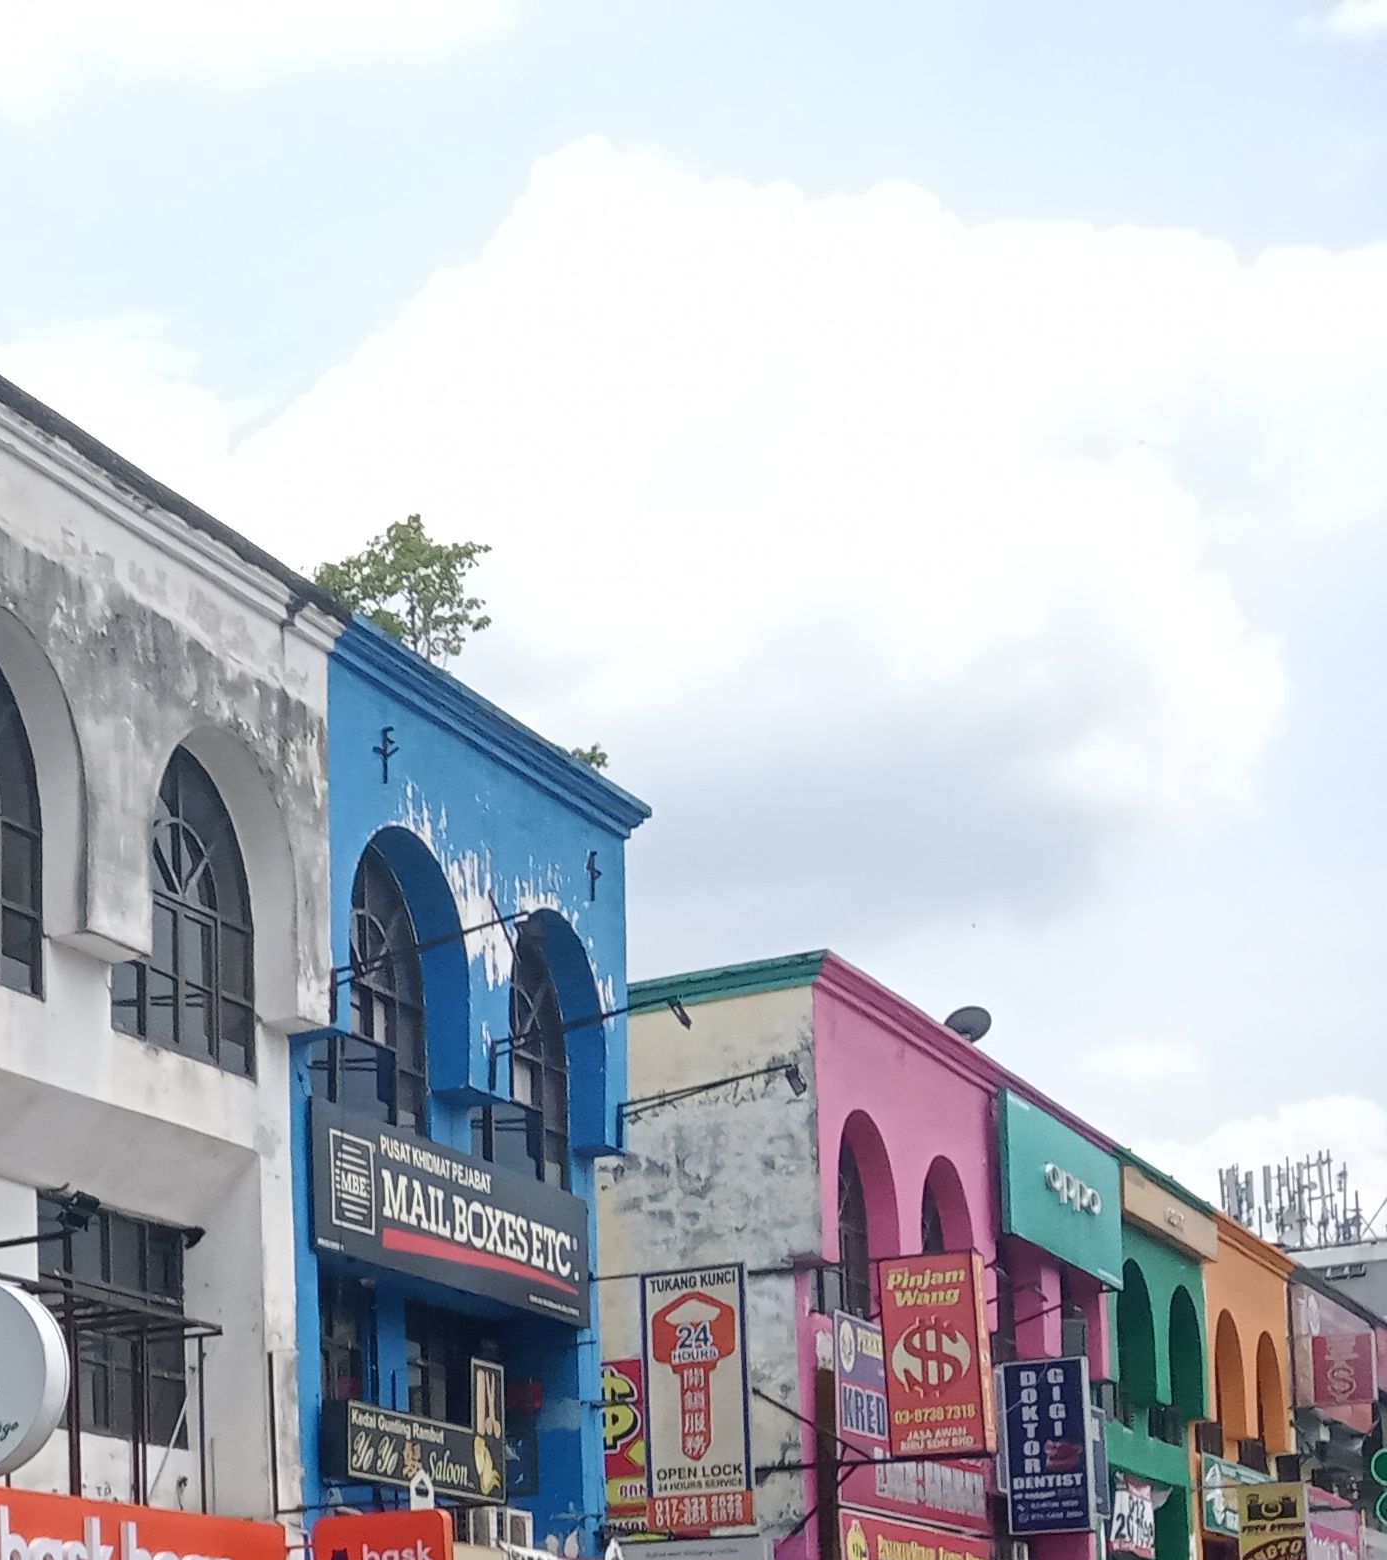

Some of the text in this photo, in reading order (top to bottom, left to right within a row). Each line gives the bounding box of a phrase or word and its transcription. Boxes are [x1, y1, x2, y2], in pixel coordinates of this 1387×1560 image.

[379, 1134, 493, 1195] PUSAT KHIDMAT PEJABAT
[340, 1171, 368, 1198] MBE
[381, 1168, 528, 1263] MAIL BOXES
[650, 1271, 736, 1294] TUKANG KUNCI
[887, 1266, 966, 1291] Pinjam
[894, 1288, 961, 1307] Wang
[677, 1321, 713, 1350] 24
[672, 1347, 718, 1363] HOURS
[1046, 1367, 1067, 1438] GIGI
[351, 1408, 376, 1430] Kedai
[378, 1413, 412, 1441] Gunting
[1018, 1370, 1042, 1474] DOKTOR
[429, 1449, 469, 1487] Saloon
[656, 1462, 743, 1481] OPEN LOCK
[1012, 1472, 1084, 1490] DENTIST
